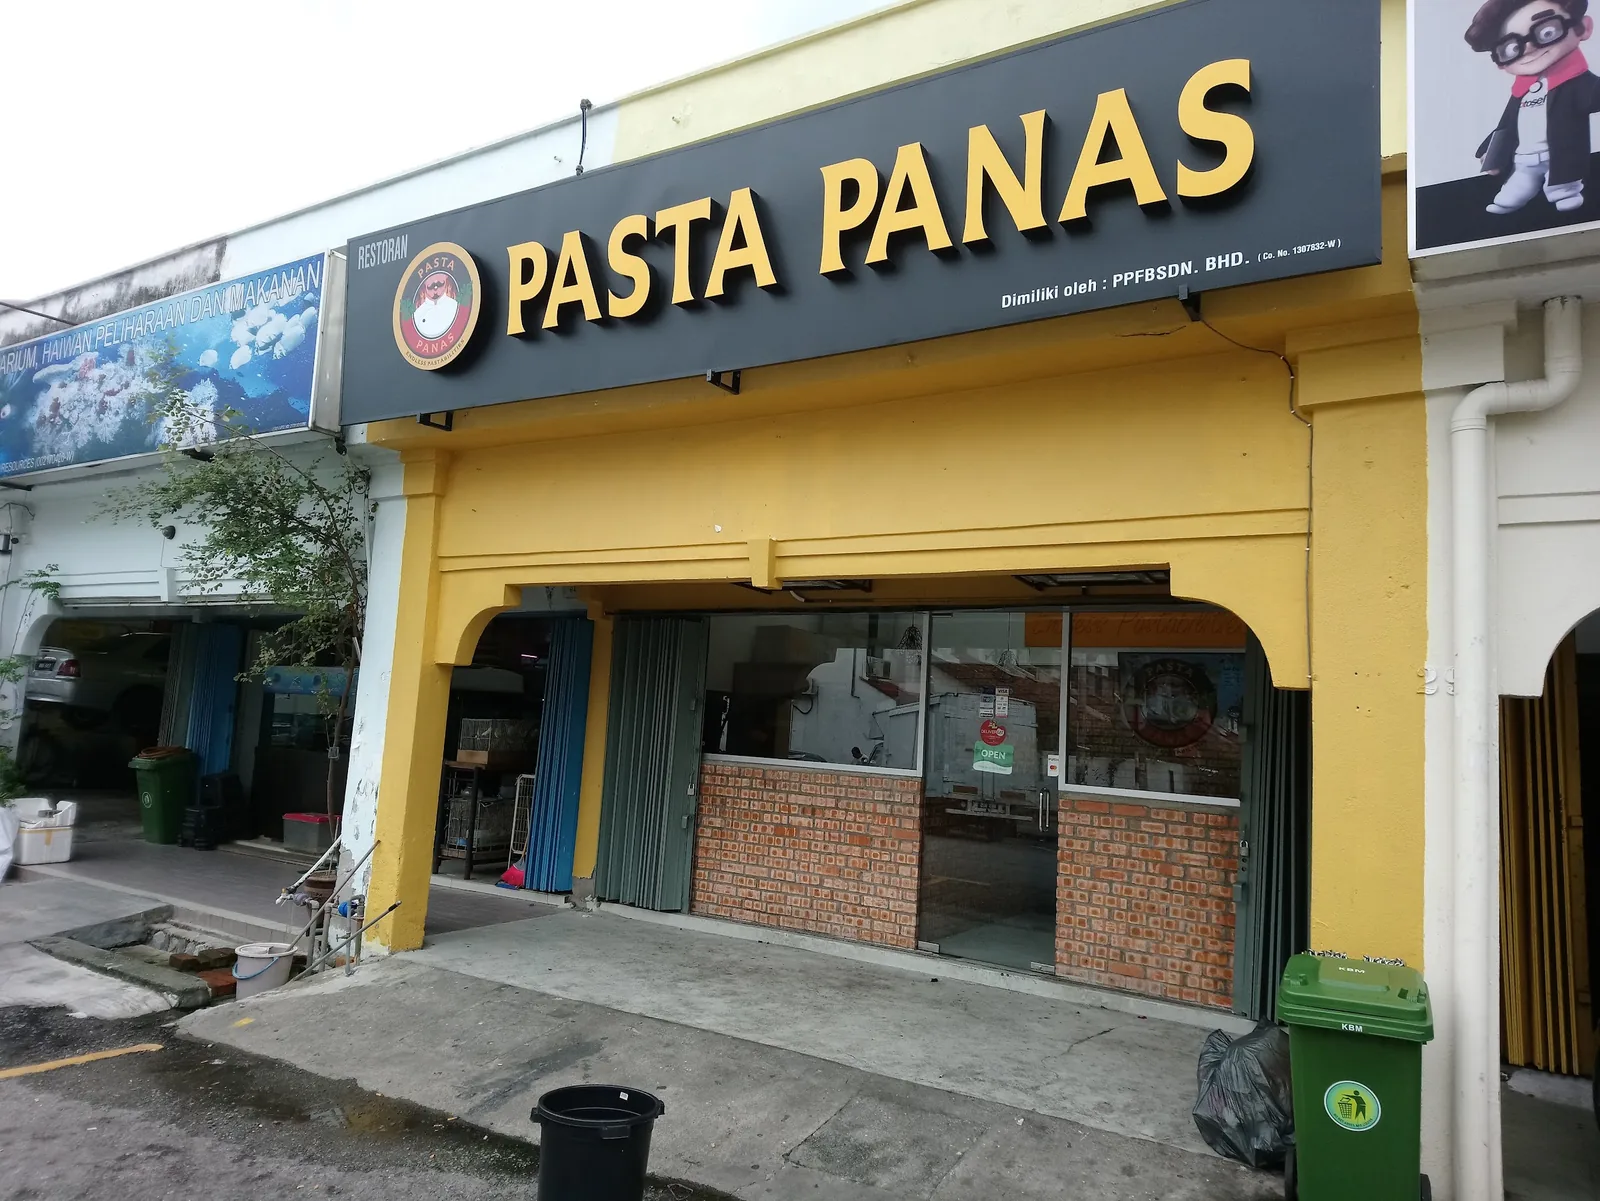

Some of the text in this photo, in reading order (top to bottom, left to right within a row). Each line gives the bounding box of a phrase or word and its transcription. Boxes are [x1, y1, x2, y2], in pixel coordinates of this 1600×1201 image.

[506, 58, 1256, 336] PASTA PANAS
[357, 234, 408, 270] RESTORAN
[417, 256, 455, 279] PASTA
[1001, 285, 1059, 308] Dimiliki
[1063, 279, 1097, 297] oleh
[1205, 251, 1250, 271] BHD.
[42, 329, 92, 364] HAIWAN
[95, 302, 189, 347] PELIHARAAN
[189, 288, 228, 323] DAN
[229, 260, 322, 313] MAKANAN
[416, 333, 455, 353] PANAS
[405, 350, 427, 366] ENDLESS
[981, 749, 1006, 760] OPEN
[1338, 966, 1366, 974] KBM
[1341, 1023, 1364, 1033] KBM
